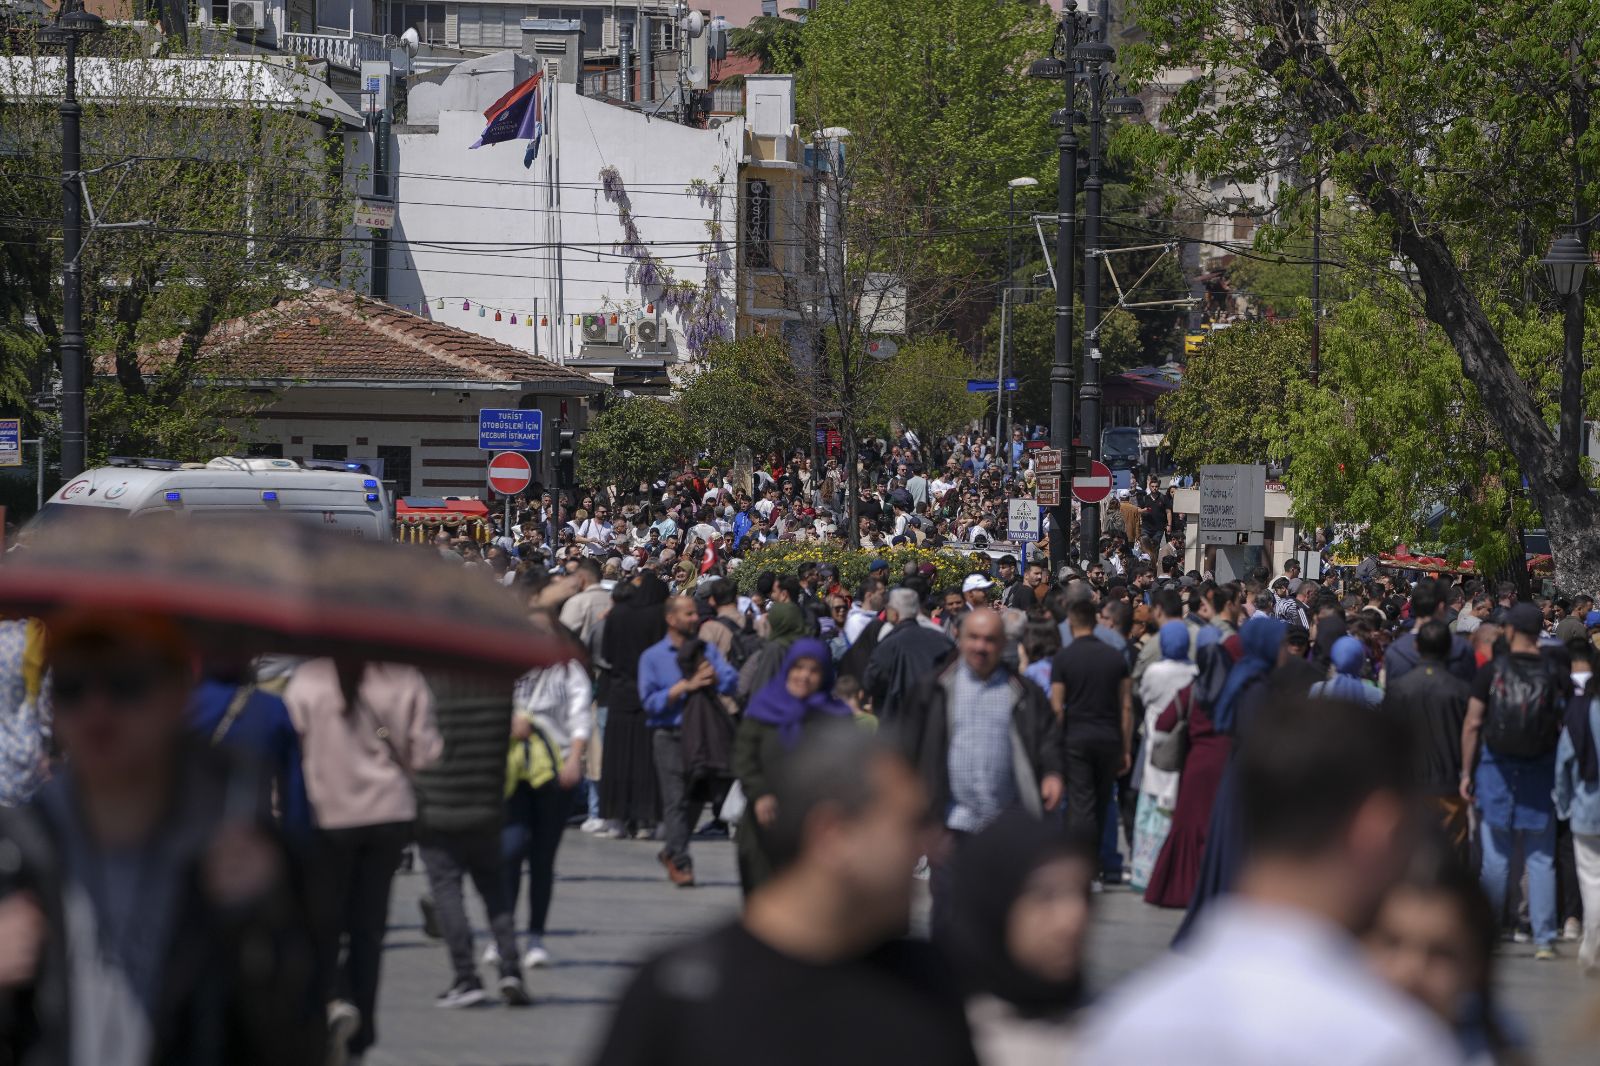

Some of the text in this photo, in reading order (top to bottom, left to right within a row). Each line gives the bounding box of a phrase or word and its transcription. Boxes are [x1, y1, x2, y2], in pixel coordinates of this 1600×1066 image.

[498, 412, 523, 420] TURİST
[482, 421, 539, 431] OTOBÜSLERİ İÇİN
[481, 431, 540, 440] MECBURİ İSTİKAMET
